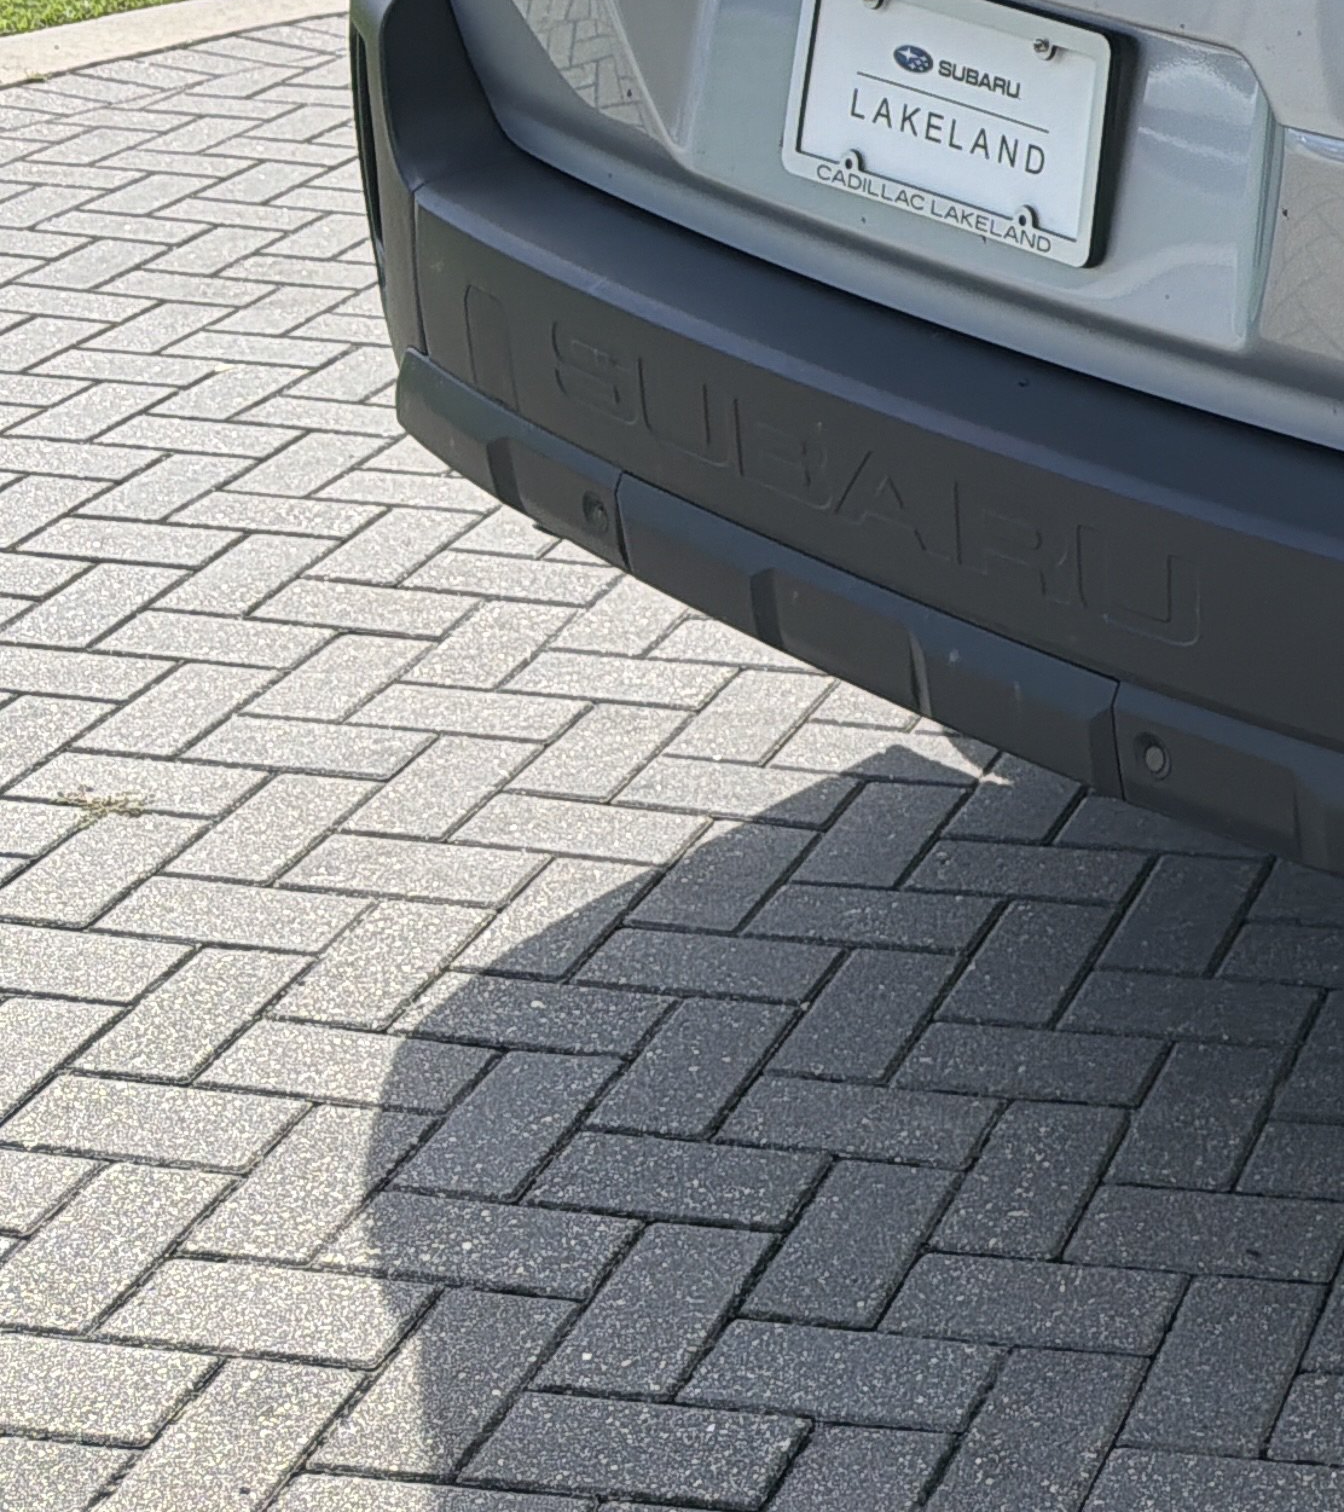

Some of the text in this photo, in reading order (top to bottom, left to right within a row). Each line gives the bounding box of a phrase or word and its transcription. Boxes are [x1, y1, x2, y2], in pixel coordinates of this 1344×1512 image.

[938, 59, 1021, 100] SUBARU
[850, 88, 1046, 175] LAKELAND
[816, 164, 1052, 253] CADILLAC LAKELAND
[549, 319, 1201, 647] SUBARU
